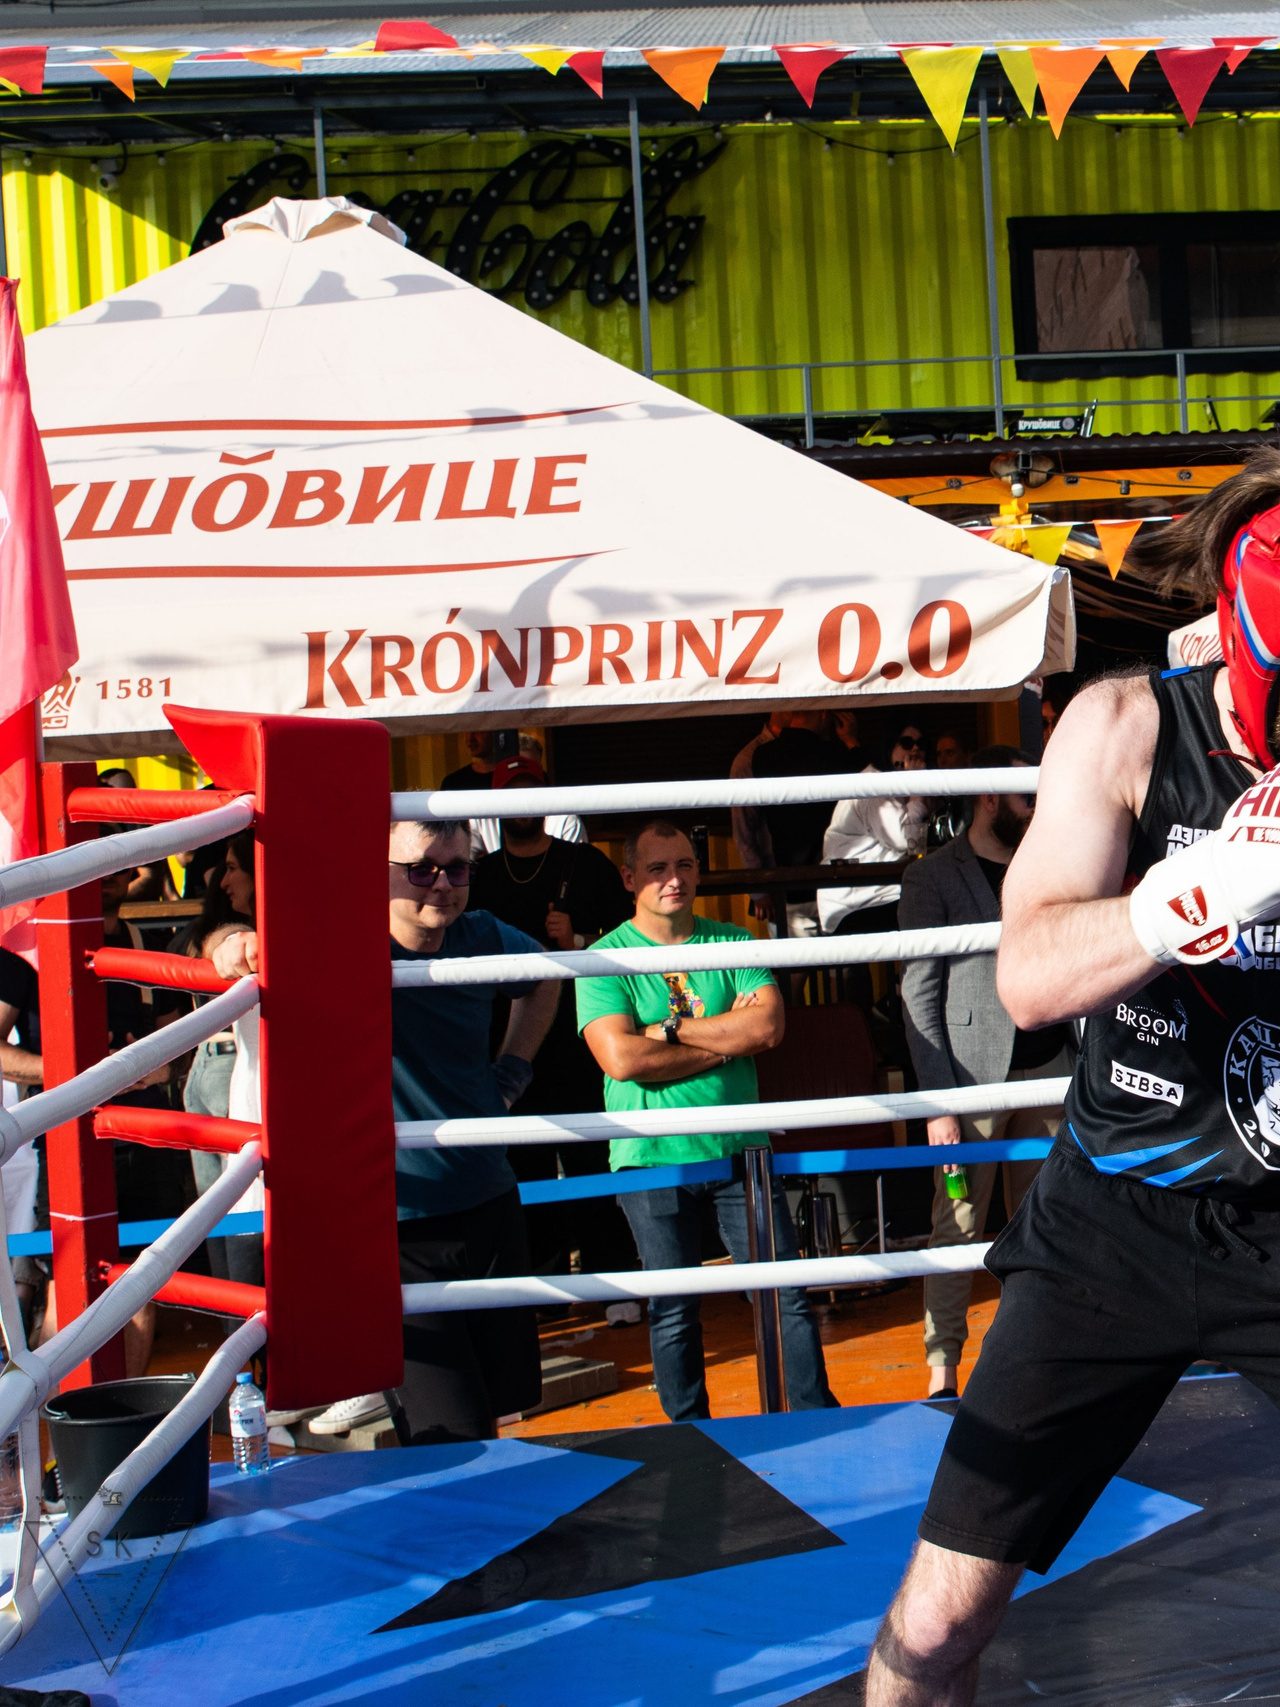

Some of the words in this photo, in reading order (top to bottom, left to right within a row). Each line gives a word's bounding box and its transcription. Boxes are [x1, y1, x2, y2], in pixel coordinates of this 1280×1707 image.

[300, 607, 784, 709] KRÓNPRINZ
[817, 599, 973, 684] 0.0
[95, 677, 172, 701] 1581
[1116, 1003, 1187, 1041] BROOM
[1136, 1032, 1159, 1047] GIN
[1115, 1068, 1179, 1099] SIBSA
